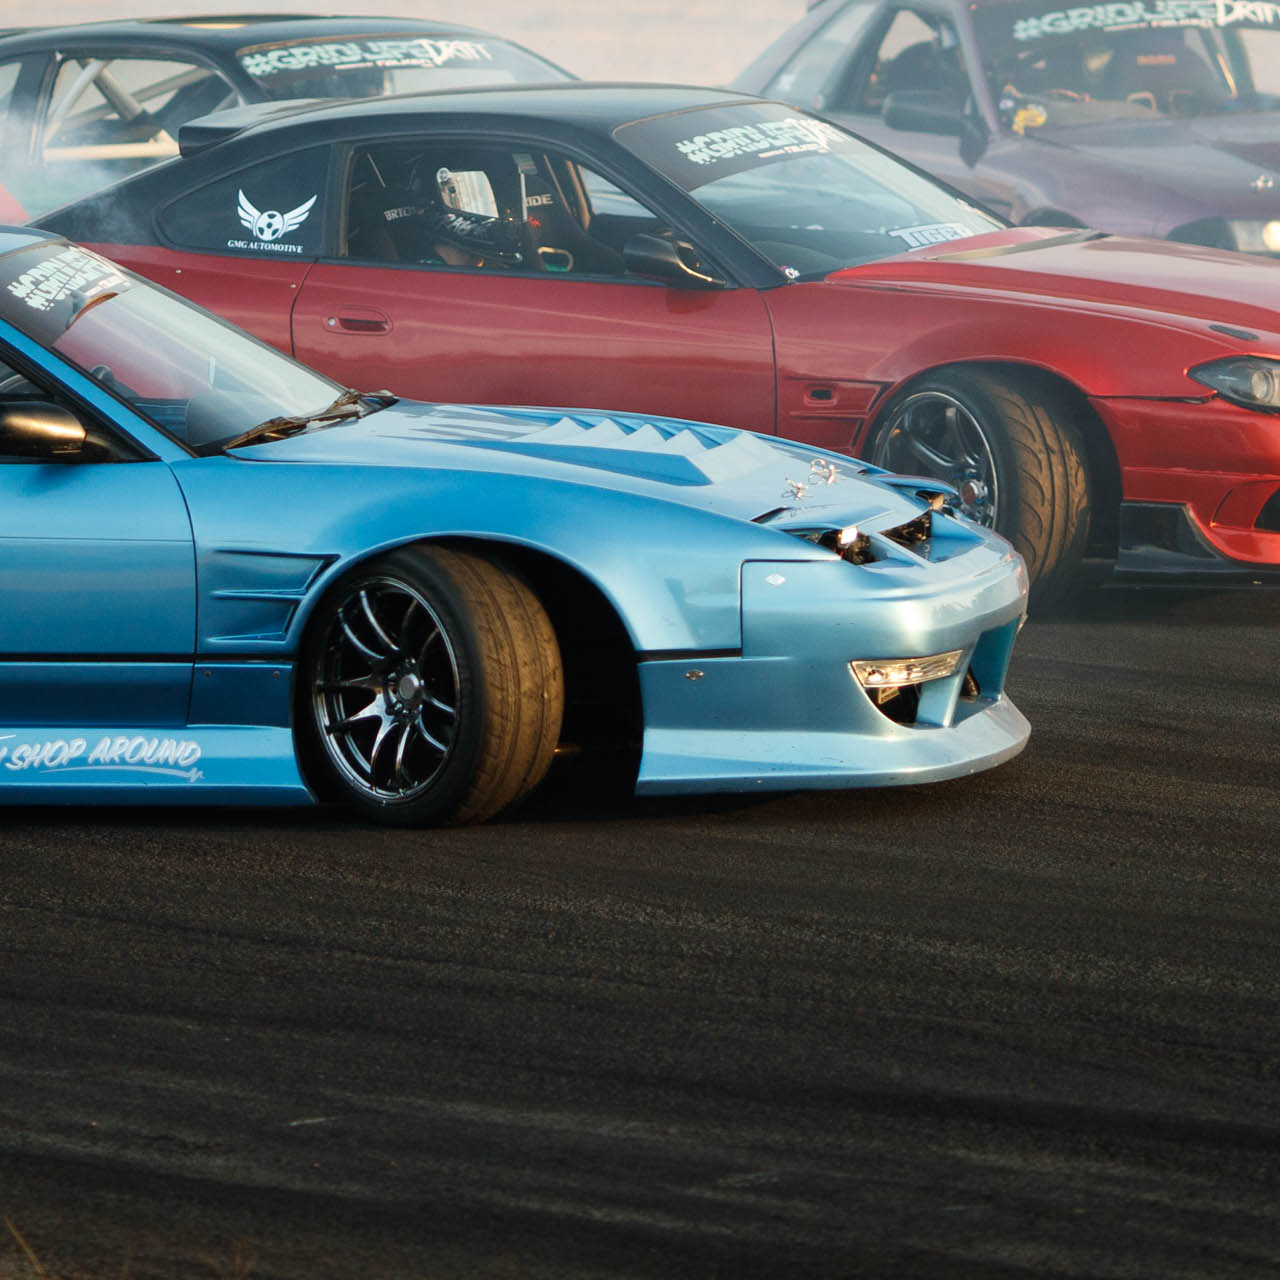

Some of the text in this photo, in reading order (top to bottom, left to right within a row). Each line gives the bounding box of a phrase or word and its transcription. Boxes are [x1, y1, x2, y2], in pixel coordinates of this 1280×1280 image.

[227, 240, 304, 254] GMG AUTOMOTIVE
[6, 737, 87, 770] SHOP
[87, 735, 202, 767] AROUND
